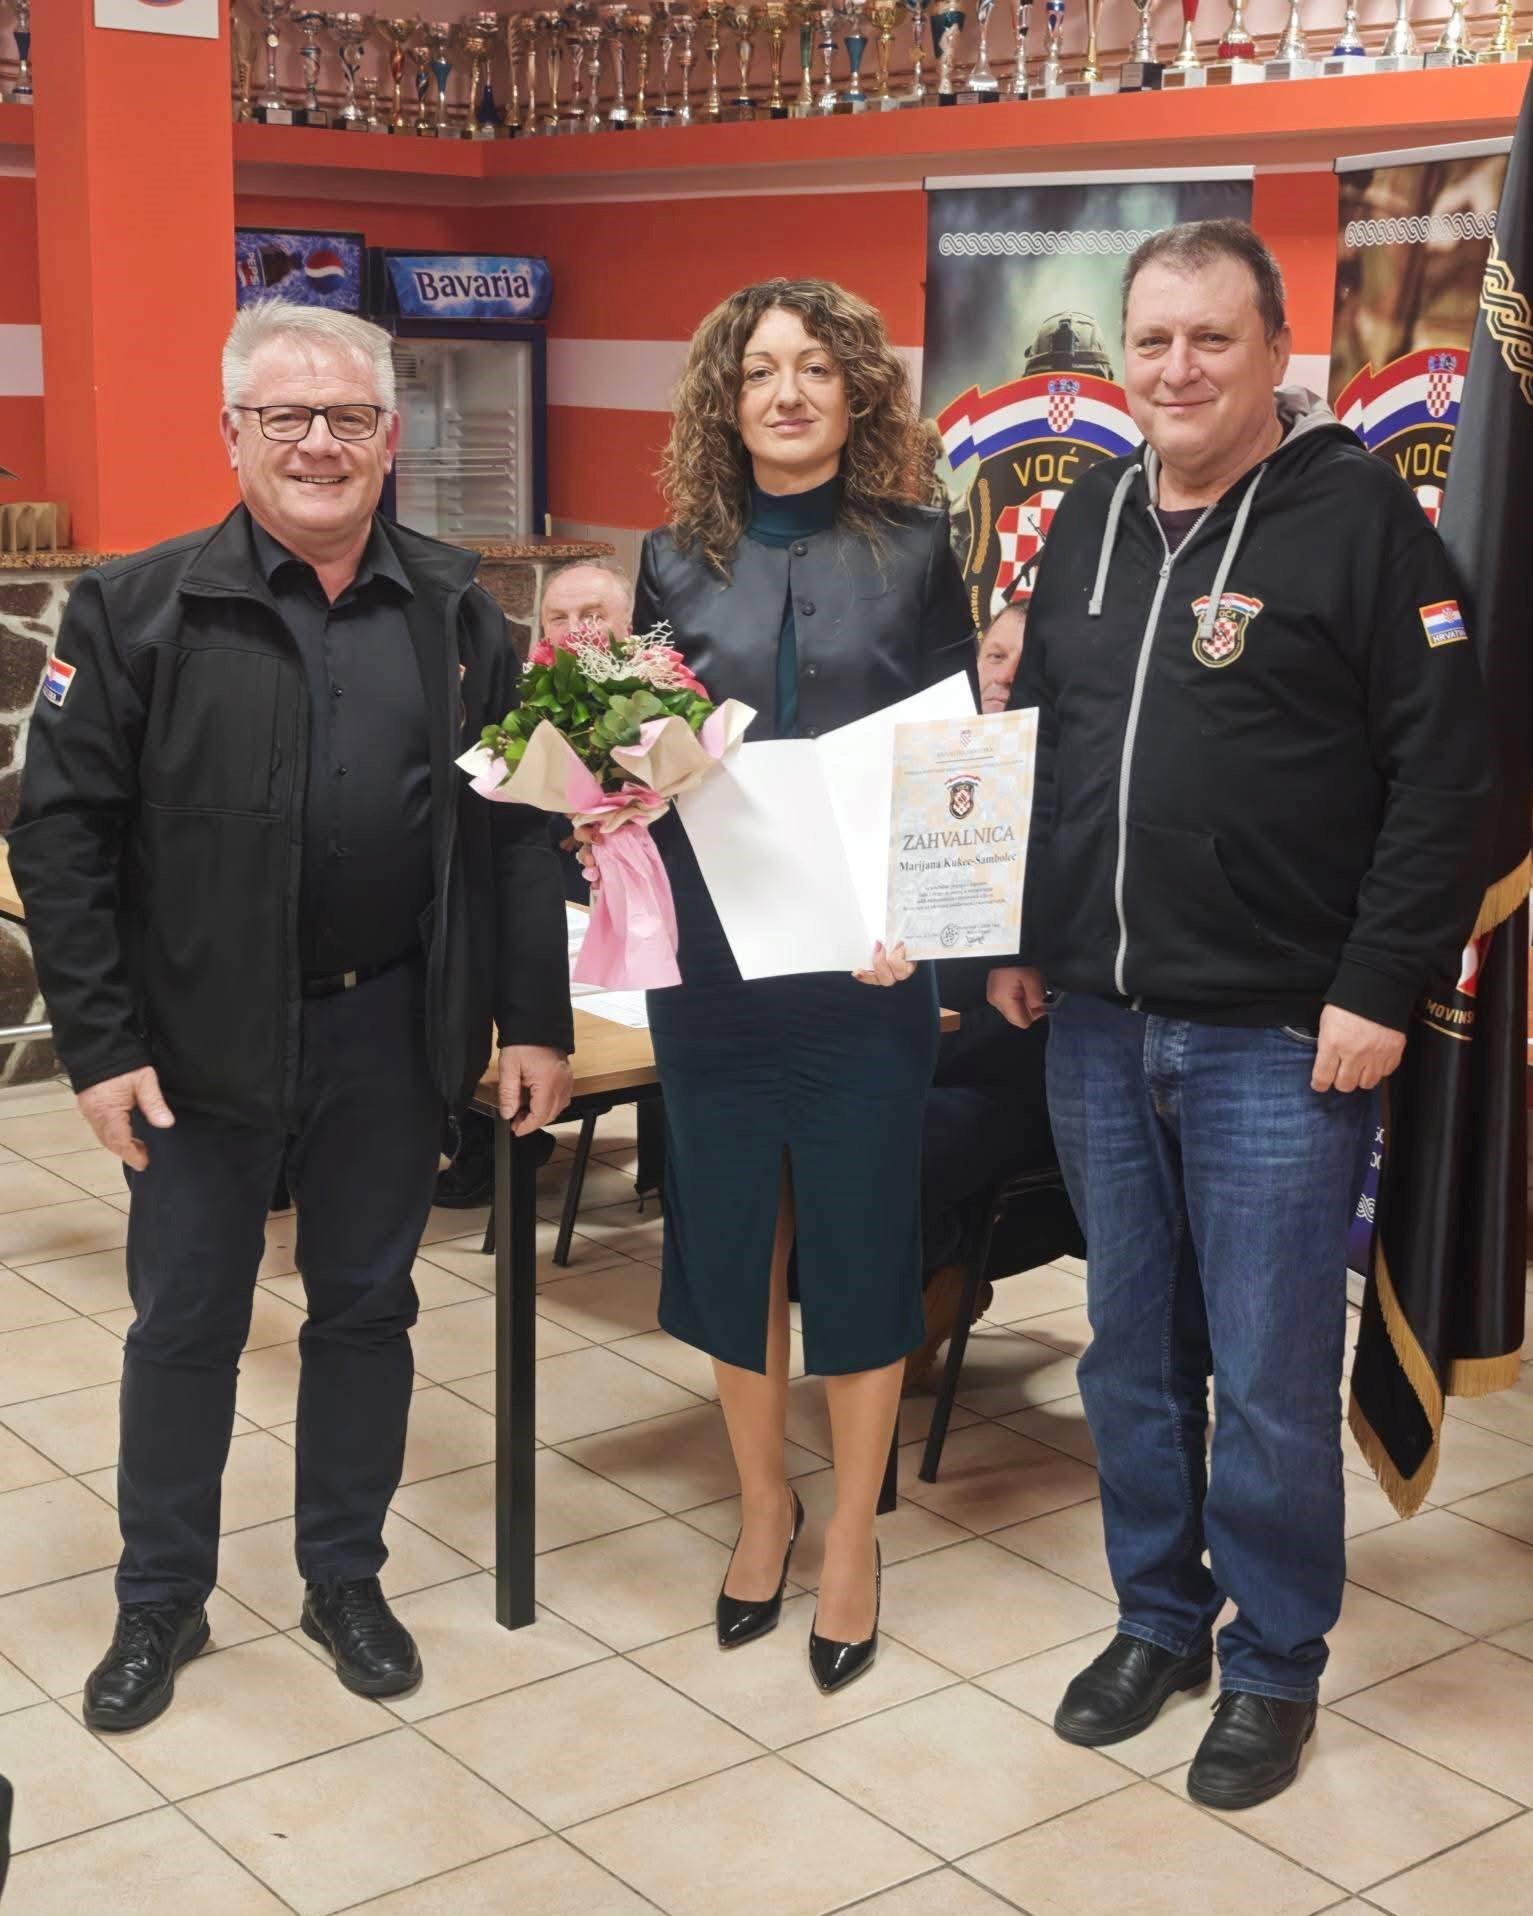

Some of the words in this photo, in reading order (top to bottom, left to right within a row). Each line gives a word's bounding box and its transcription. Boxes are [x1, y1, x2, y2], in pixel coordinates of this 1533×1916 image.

[415, 268, 530, 302] Bavaria
[1012, 446, 1096, 488] VOĆ
[1394, 433, 1453, 480] VOĆ
[903, 825, 1016, 851] ZAHVALNICA
[899, 860, 941, 873] Marijana
